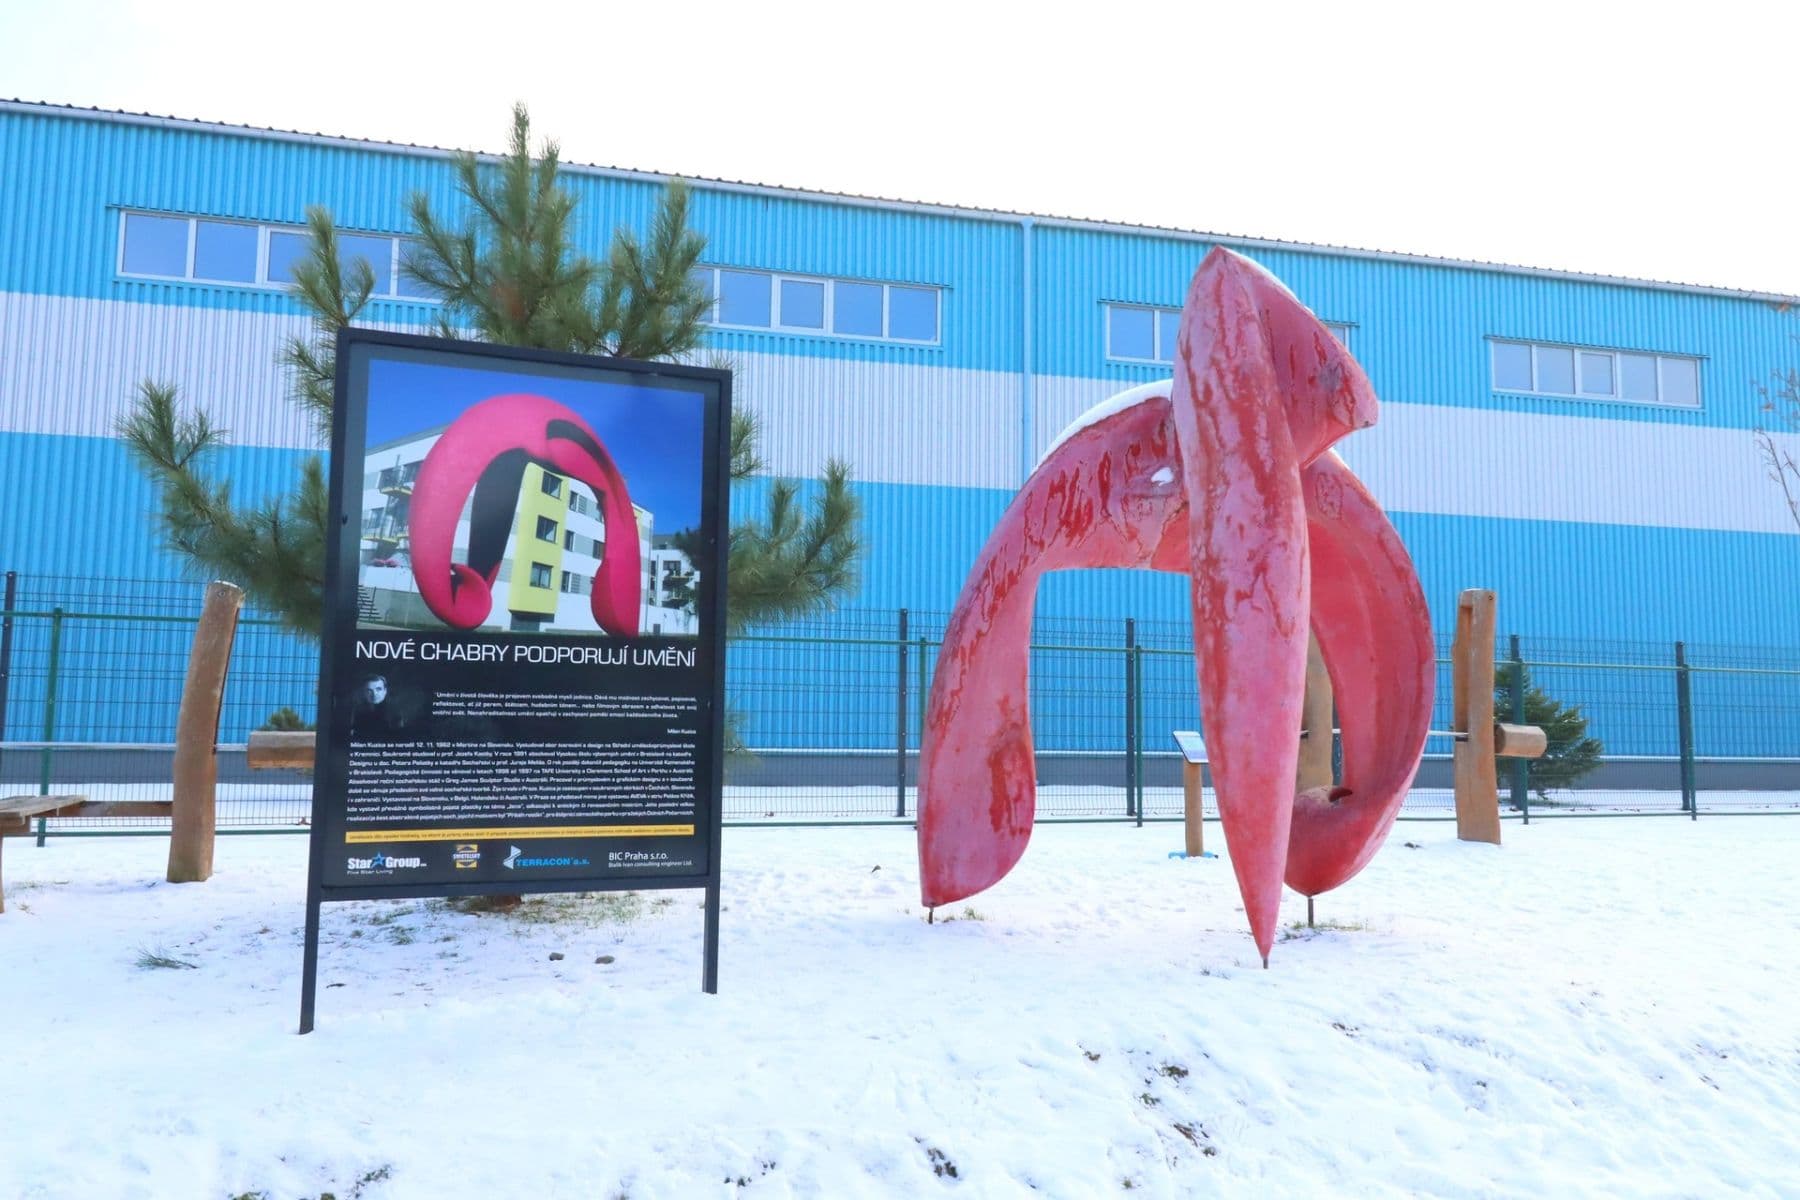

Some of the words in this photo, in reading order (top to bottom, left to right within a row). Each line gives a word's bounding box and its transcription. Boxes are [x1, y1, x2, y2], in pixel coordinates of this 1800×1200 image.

[356, 638, 416, 660] NOVÉ
[420, 642, 509, 662] CHABRY
[514, 645, 629, 665] PODPORUJÍ
[633, 646, 697, 667] UMĚNÍ
[347, 857, 373, 869] Star
[385, 856, 421, 868] Group
[608, 852, 623, 861] BIC
[624, 851, 648, 861] Praha
[650, 852, 669, 860] s.r.o.
